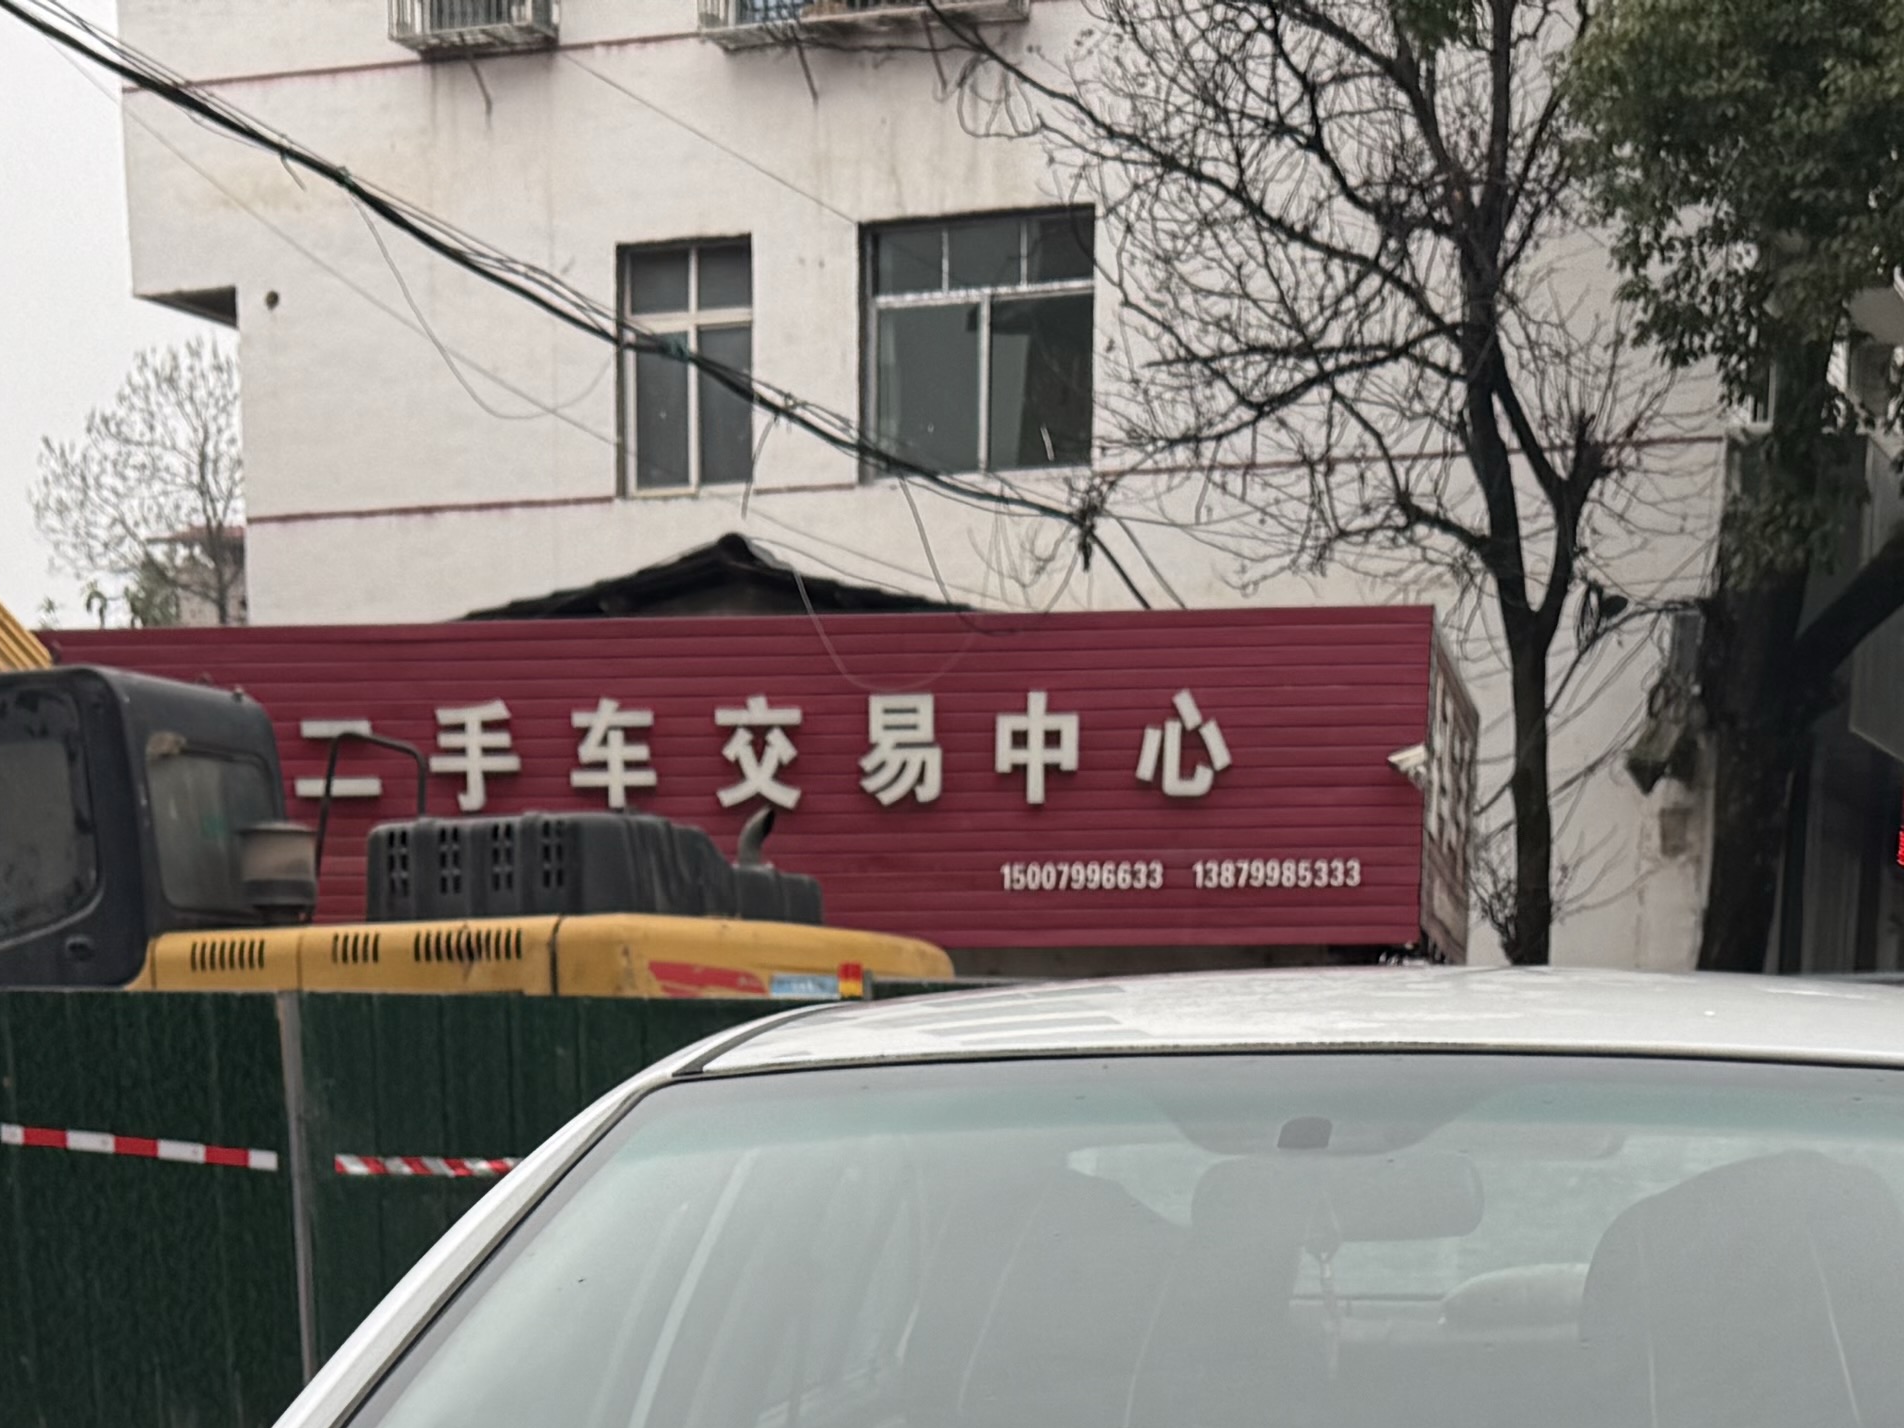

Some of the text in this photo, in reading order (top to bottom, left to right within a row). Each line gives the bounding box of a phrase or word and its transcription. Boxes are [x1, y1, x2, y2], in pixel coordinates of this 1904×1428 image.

[294, 687, 1233, 812] 二手车交易中心
[1000, 858, 1361, 891] 15007996633 13879985333
